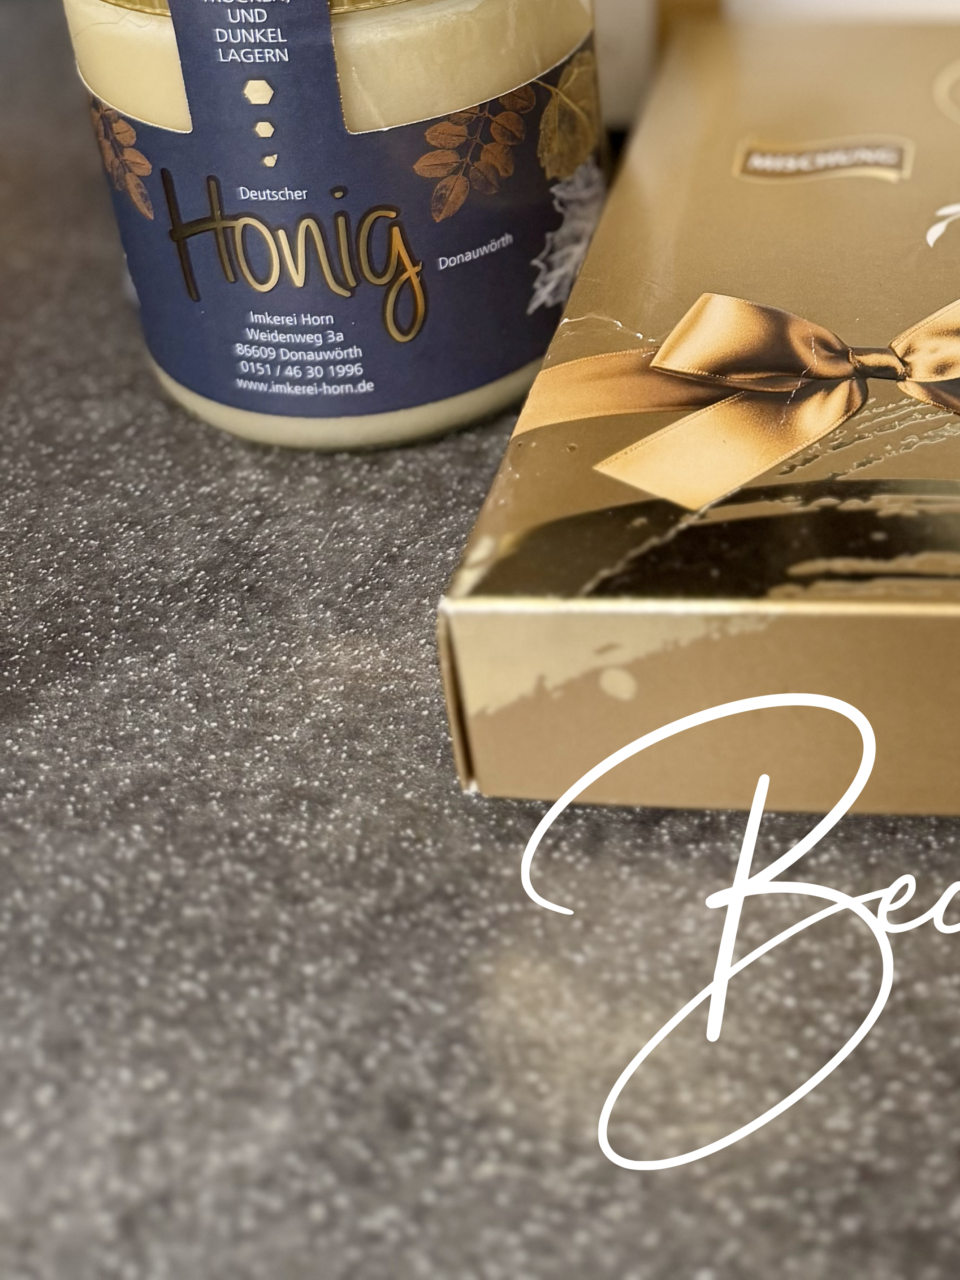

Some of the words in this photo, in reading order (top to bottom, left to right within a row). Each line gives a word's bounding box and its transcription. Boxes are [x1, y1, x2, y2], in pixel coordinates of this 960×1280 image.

[227, 8, 268, 24] UND
[215, 28, 288, 44] DUNKEL
[219, 48, 290, 63] LAGERN
[746, 147, 899, 173] MISCHUNG
[239, 186, 308, 201] Deutscher
[160, 167, 427, 343] Honig
[438, 232, 514, 271] Donauwörth
[249, 310, 298, 326] Imkerei
[301, 313, 334, 326] Horn
[246, 328, 323, 346] Weidenweg
[326, 330, 344, 343] 3a
[235, 343, 276, 359] 86609
[280, 345, 363, 361] Donauwörth
[240, 360, 271, 376] 0151
[284, 365, 303, 378] 46
[306, 365, 324, 378] 30
[328, 363, 364, 378] 1996
[236, 378, 375, 395] www.imkerei-horn.de
